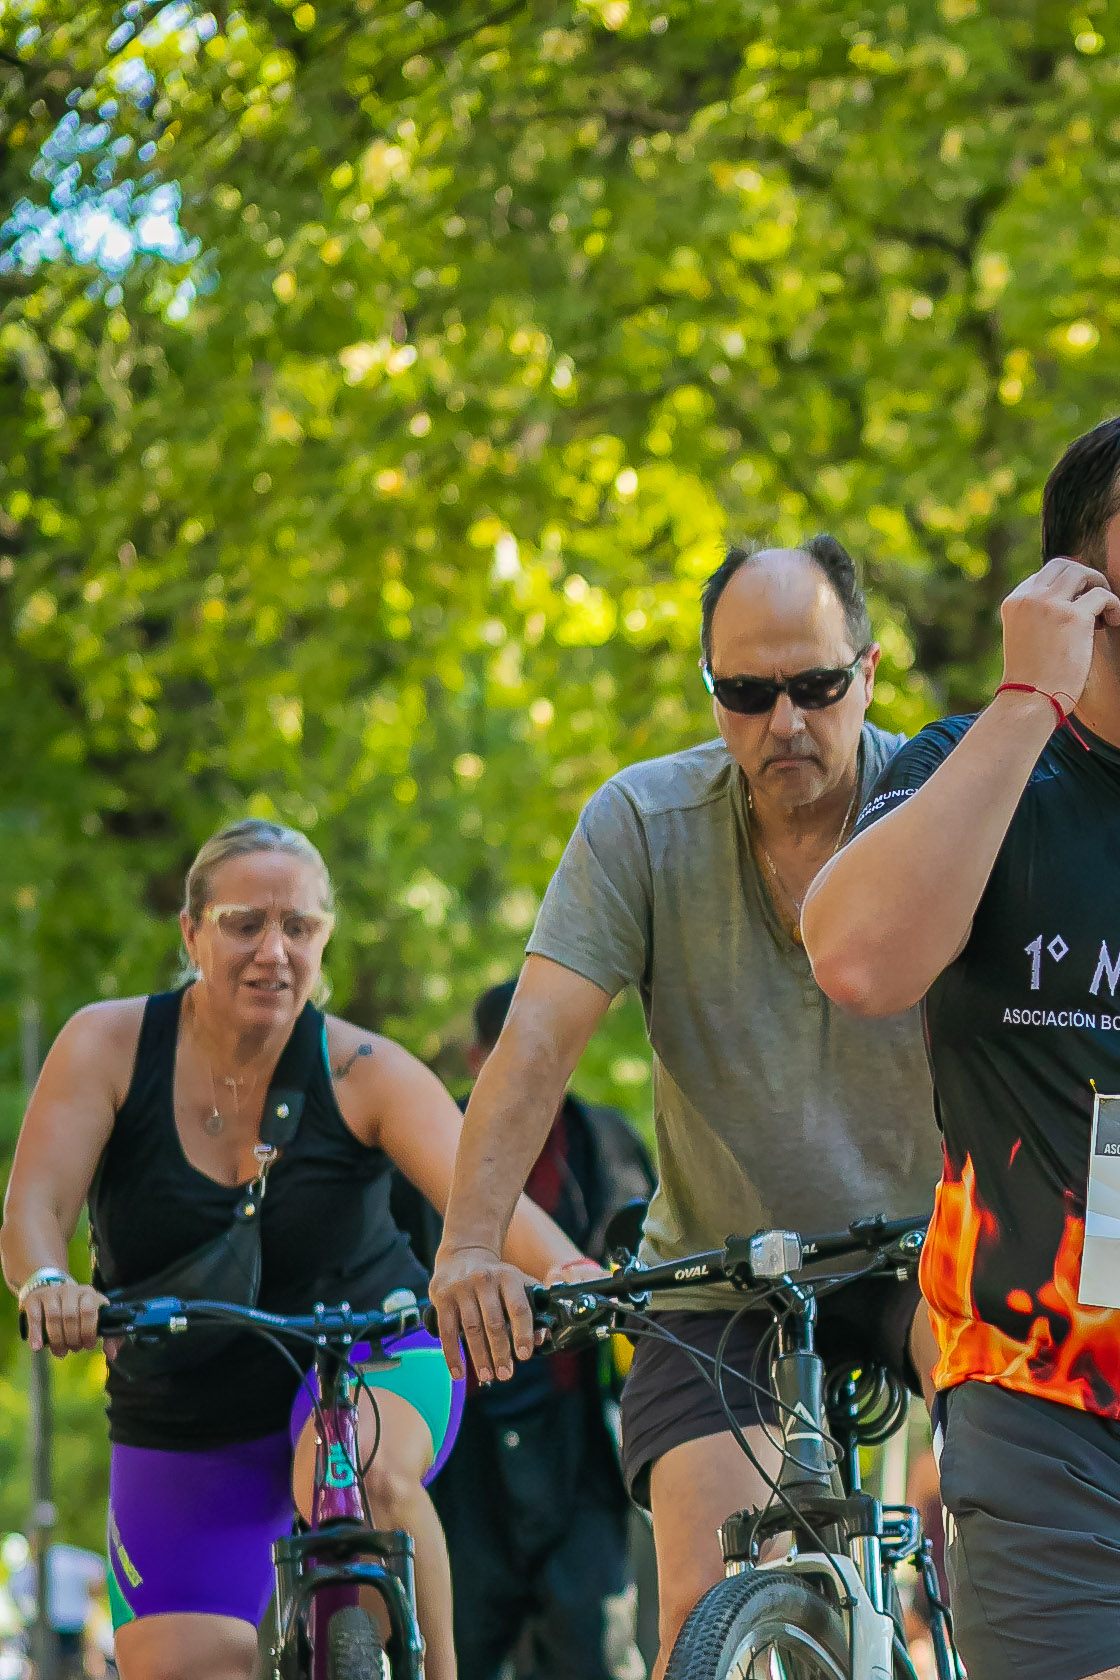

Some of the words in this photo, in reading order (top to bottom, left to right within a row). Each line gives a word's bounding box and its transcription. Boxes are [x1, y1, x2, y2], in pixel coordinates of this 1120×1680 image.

[1003, 1008, 1096, 1029] ASOCIACIÓN
[801, 1243, 818, 1254] AL
[674, 1264, 709, 1281] OVAL
